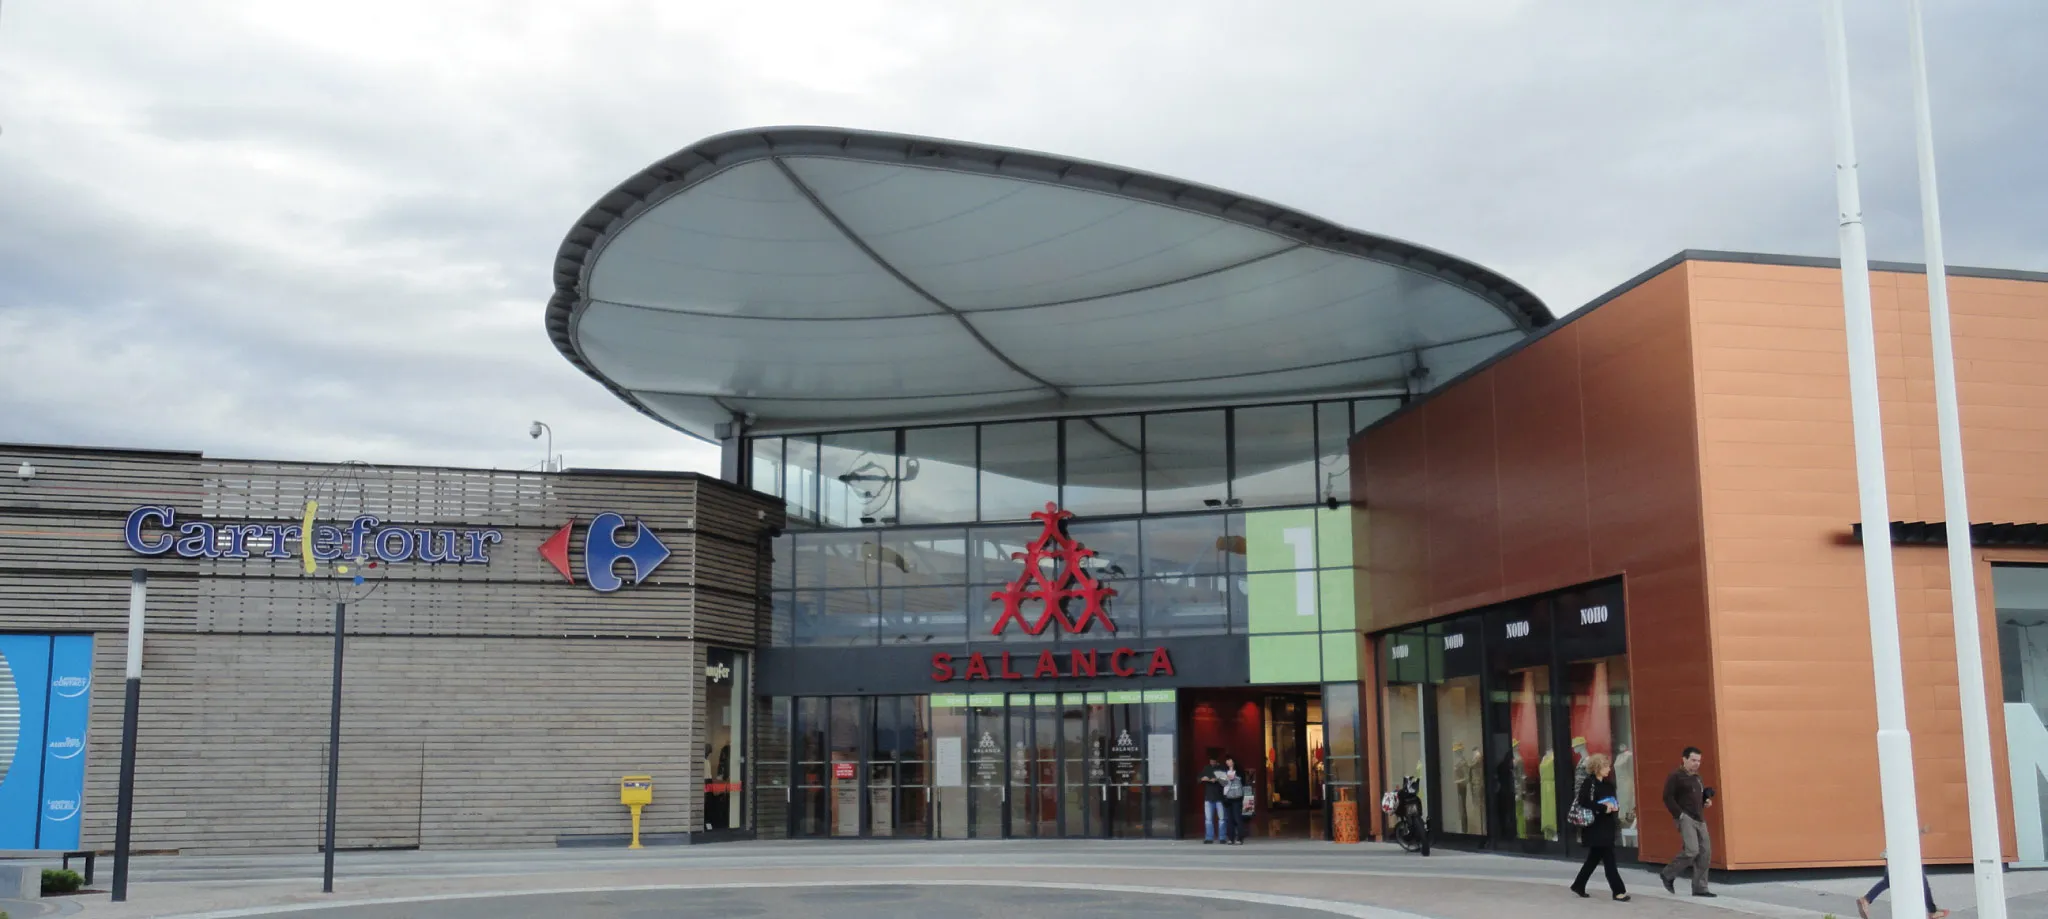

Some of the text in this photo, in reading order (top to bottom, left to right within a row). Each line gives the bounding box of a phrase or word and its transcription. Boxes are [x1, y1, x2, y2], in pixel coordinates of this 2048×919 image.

[124, 505, 502, 563] Carrefour
[1283, 526, 1315, 616] 1
[1580, 605, 1608, 625] NOHO
[1506, 620, 1530, 639] NOHO
[1444, 633, 1464, 650] NOHO
[1392, 644, 1409, 660] NOHO
[931, 646, 1175, 682] SALANCA
